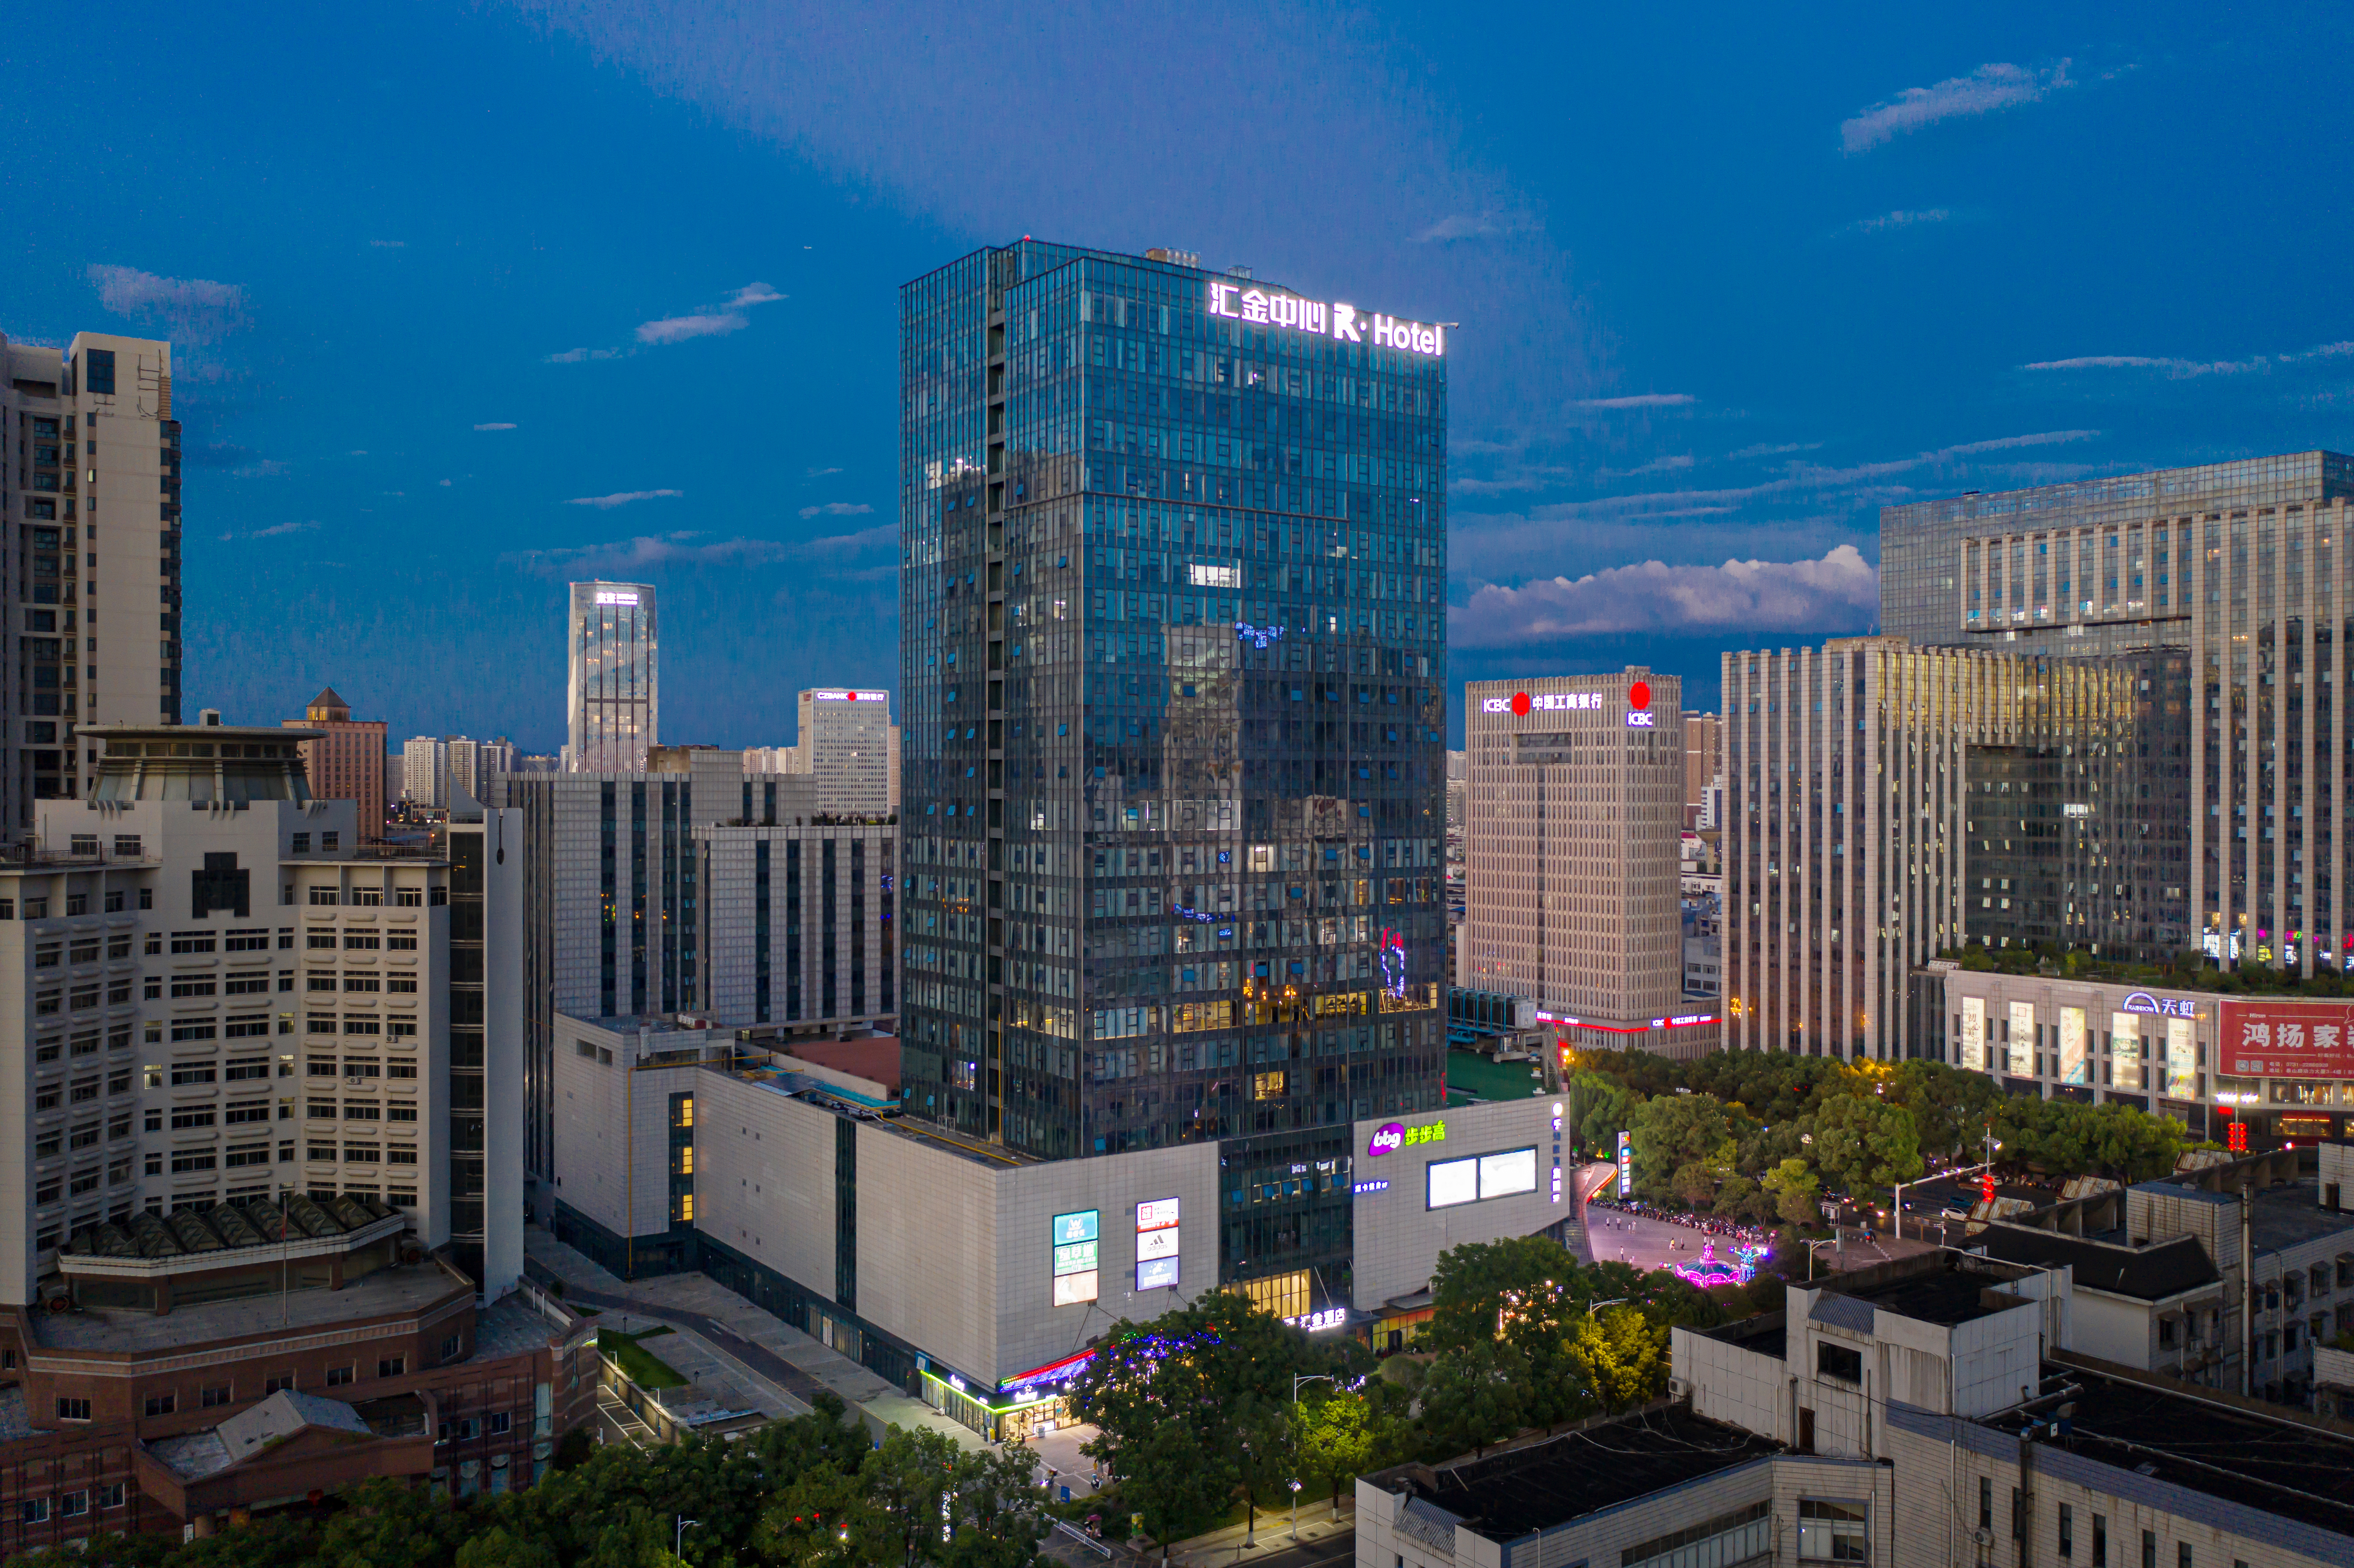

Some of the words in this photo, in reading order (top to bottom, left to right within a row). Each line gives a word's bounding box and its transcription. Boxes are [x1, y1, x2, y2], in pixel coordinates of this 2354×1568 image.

[1210, 282, 1326, 334] 汇金中心
[1374, 314, 1442, 356] Hotel
[1483, 698, 1510, 712] ICBC
[1532, 693, 1603, 711] 中国工商银行
[1627, 712, 1653, 726] ICBC
[2162, 999, 2195, 1017] 天虹
[1373, 1129, 1402, 1149] bbg
[1405, 1120, 1446, 1146] 步步高
[1300, 1308, 1345, 1328] 汇金酒店
